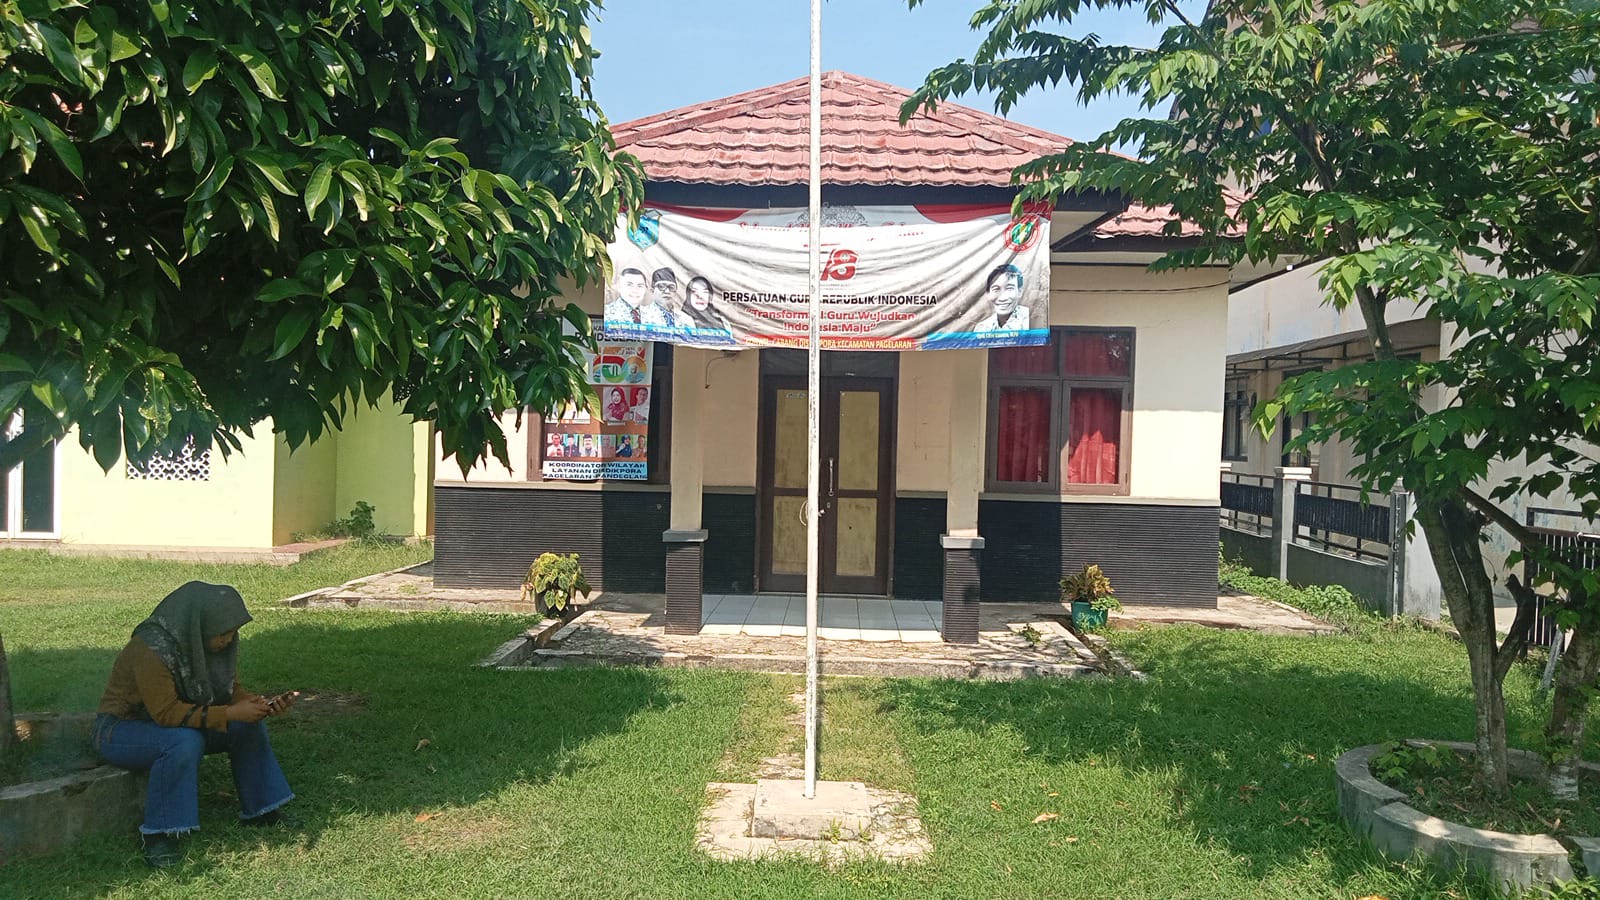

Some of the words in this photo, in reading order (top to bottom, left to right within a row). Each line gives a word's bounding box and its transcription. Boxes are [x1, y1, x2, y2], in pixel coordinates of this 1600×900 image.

[723, 291, 787, 303] PERSATUAN
[789, 293, 811, 304] GUR
[822, 294, 876, 305] REPUBLIK
[878, 295, 937, 305] INDONESIA
[745, 308, 824, 320] "Transformi
[827, 310, 855, 320] Guru
[858, 311, 915, 322] Wujudkan
[784, 322, 839, 332] Indosia
[837, 339, 875, 349] KECAMATAN
[876, 340, 912, 349] PAGELARAN
